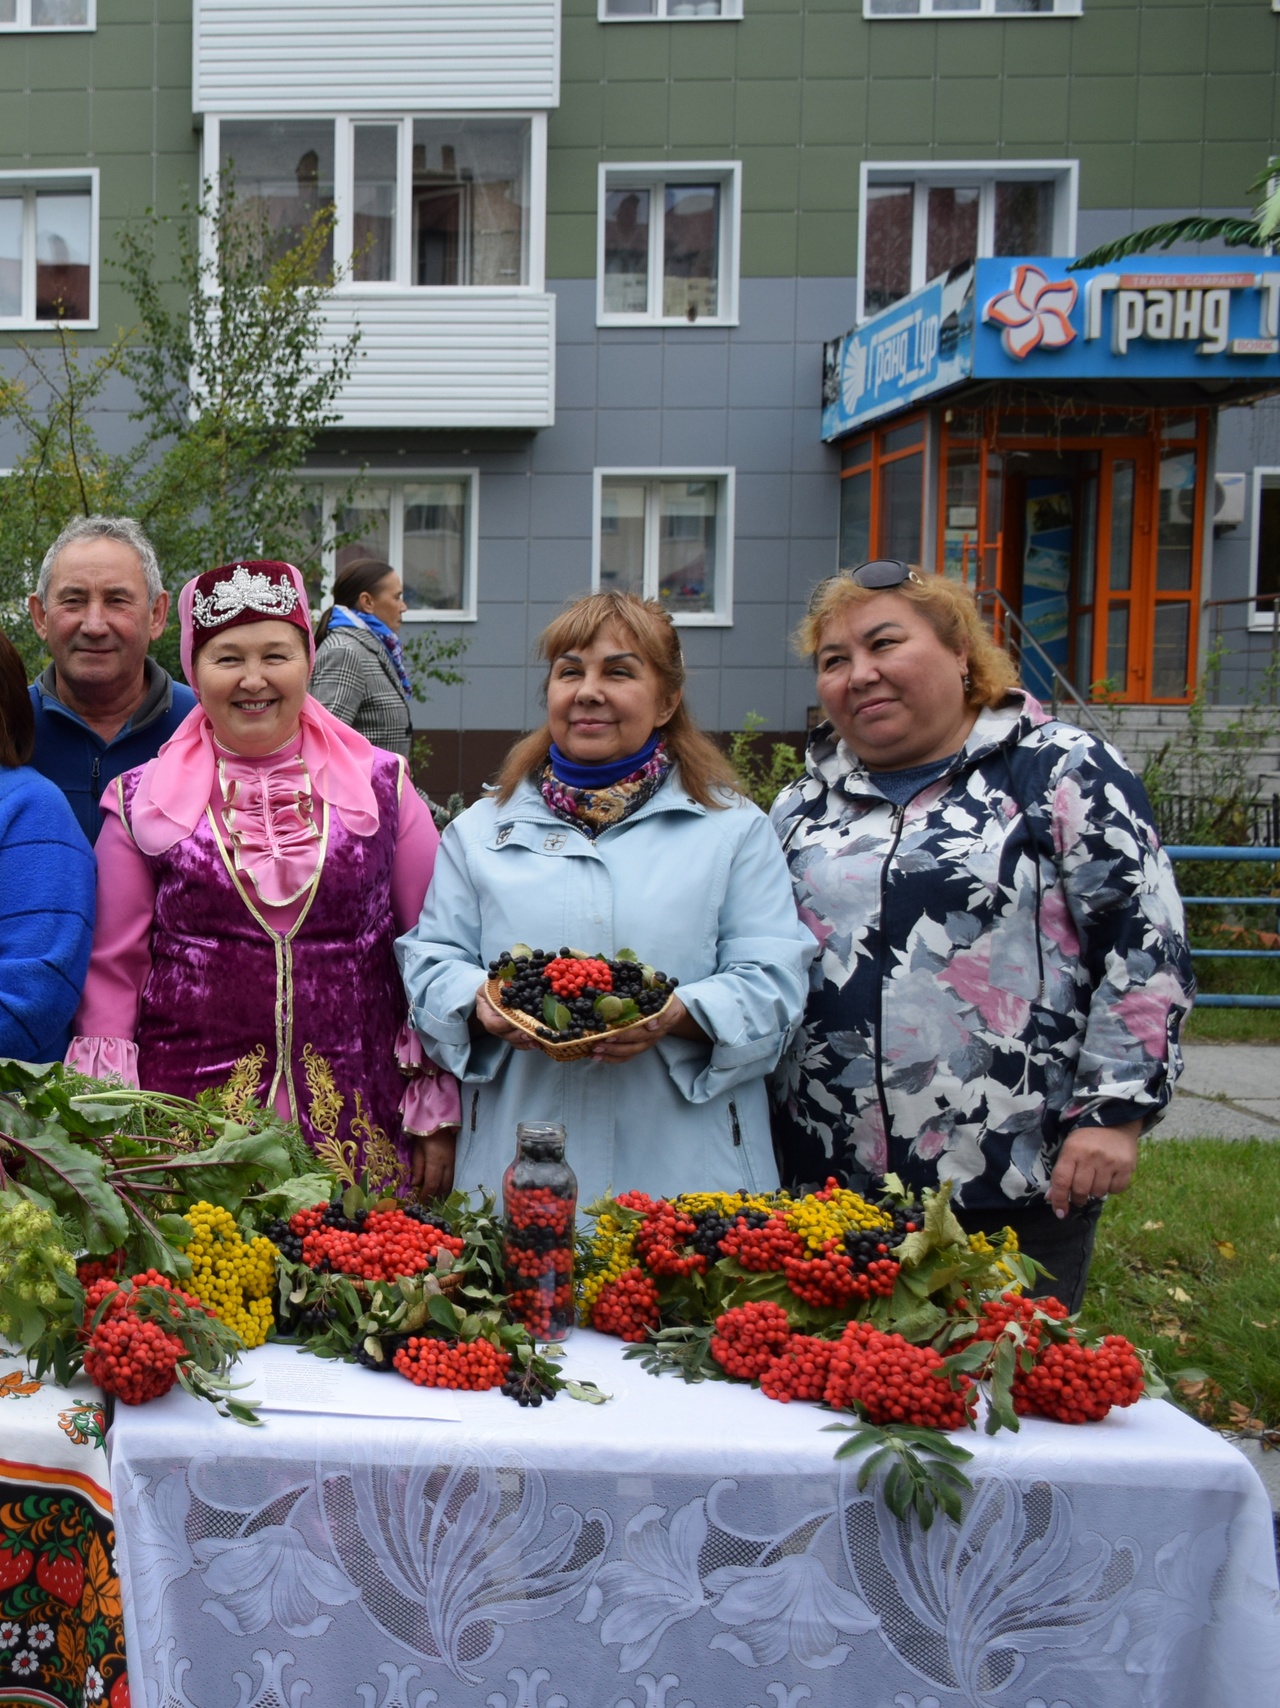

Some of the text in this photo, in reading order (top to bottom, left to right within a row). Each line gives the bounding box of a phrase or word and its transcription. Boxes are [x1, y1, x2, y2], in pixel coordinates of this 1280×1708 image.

[1086, 273, 1230, 355] Гранд
[1132, 275, 1244, 287] TRAVEL COMPANY
[867, 308, 939, 399] Гранд Тур
